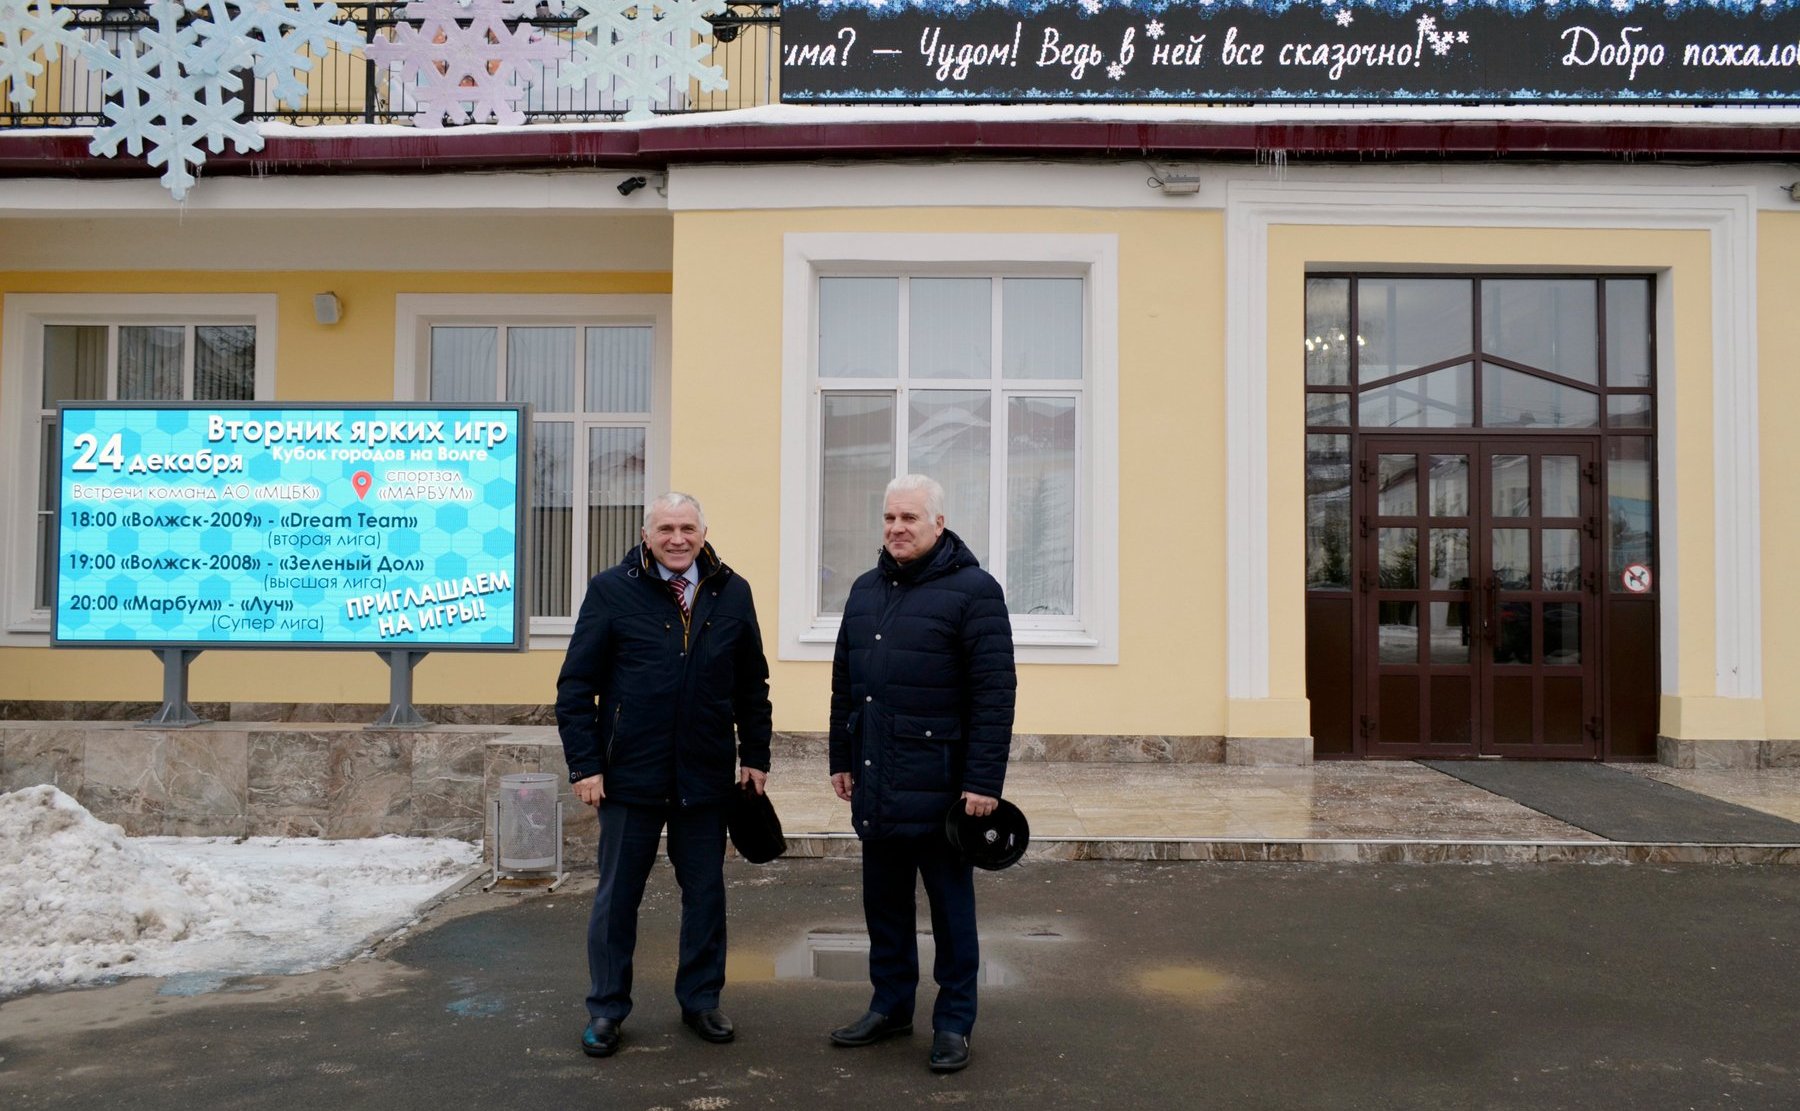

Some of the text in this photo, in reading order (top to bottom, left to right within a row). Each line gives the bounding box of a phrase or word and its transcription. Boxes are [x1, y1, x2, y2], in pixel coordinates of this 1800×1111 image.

[920, 22, 1021, 81] Чудом!
[1036, 27, 1102, 80] Ведь
[1120, 27, 1136, 66] в
[1152, 34, 1206, 66] ней
[1222, 27, 1264, 66] все
[1279, 24, 1427, 80] сказочно!
[1561, 26, 1665, 80] Добро
[208, 414, 509, 449] Вторник ярких игр
[72, 433, 243, 477] 24 декабря
[272, 446, 488, 464] Кубок городов на Волге
[386, 470, 462, 484] спортзал
[73, 484, 320, 501] Встречи команд АО «МЦБК»
[378, 485, 473, 501] «МАРБУМ»
[71, 511, 117, 527] 18:00
[121, 511, 262, 528] «Волжск-2009»
[280, 512, 352, 528] «Dream
[357, 512, 418, 528] Team»
[267, 531, 381, 549] (вторая лига)
[70, 554, 116, 570] 19:00
[120, 554, 261, 571] «Волжск-2008»
[279, 554, 372, 571] «Зеленый
[377, 556, 424, 572] Дол»
[263, 574, 387, 592] (высшая лига)
[345, 570, 512, 620] ПРИГЛАШАЕМ
[70, 594, 118, 611] 20:00
[123, 595, 222, 614] «Марбум»
[240, 595, 294, 615] «Луч»
[211, 614, 325, 632] (Супер лига)
[378, 598, 488, 639] НА ИГРЫ!
